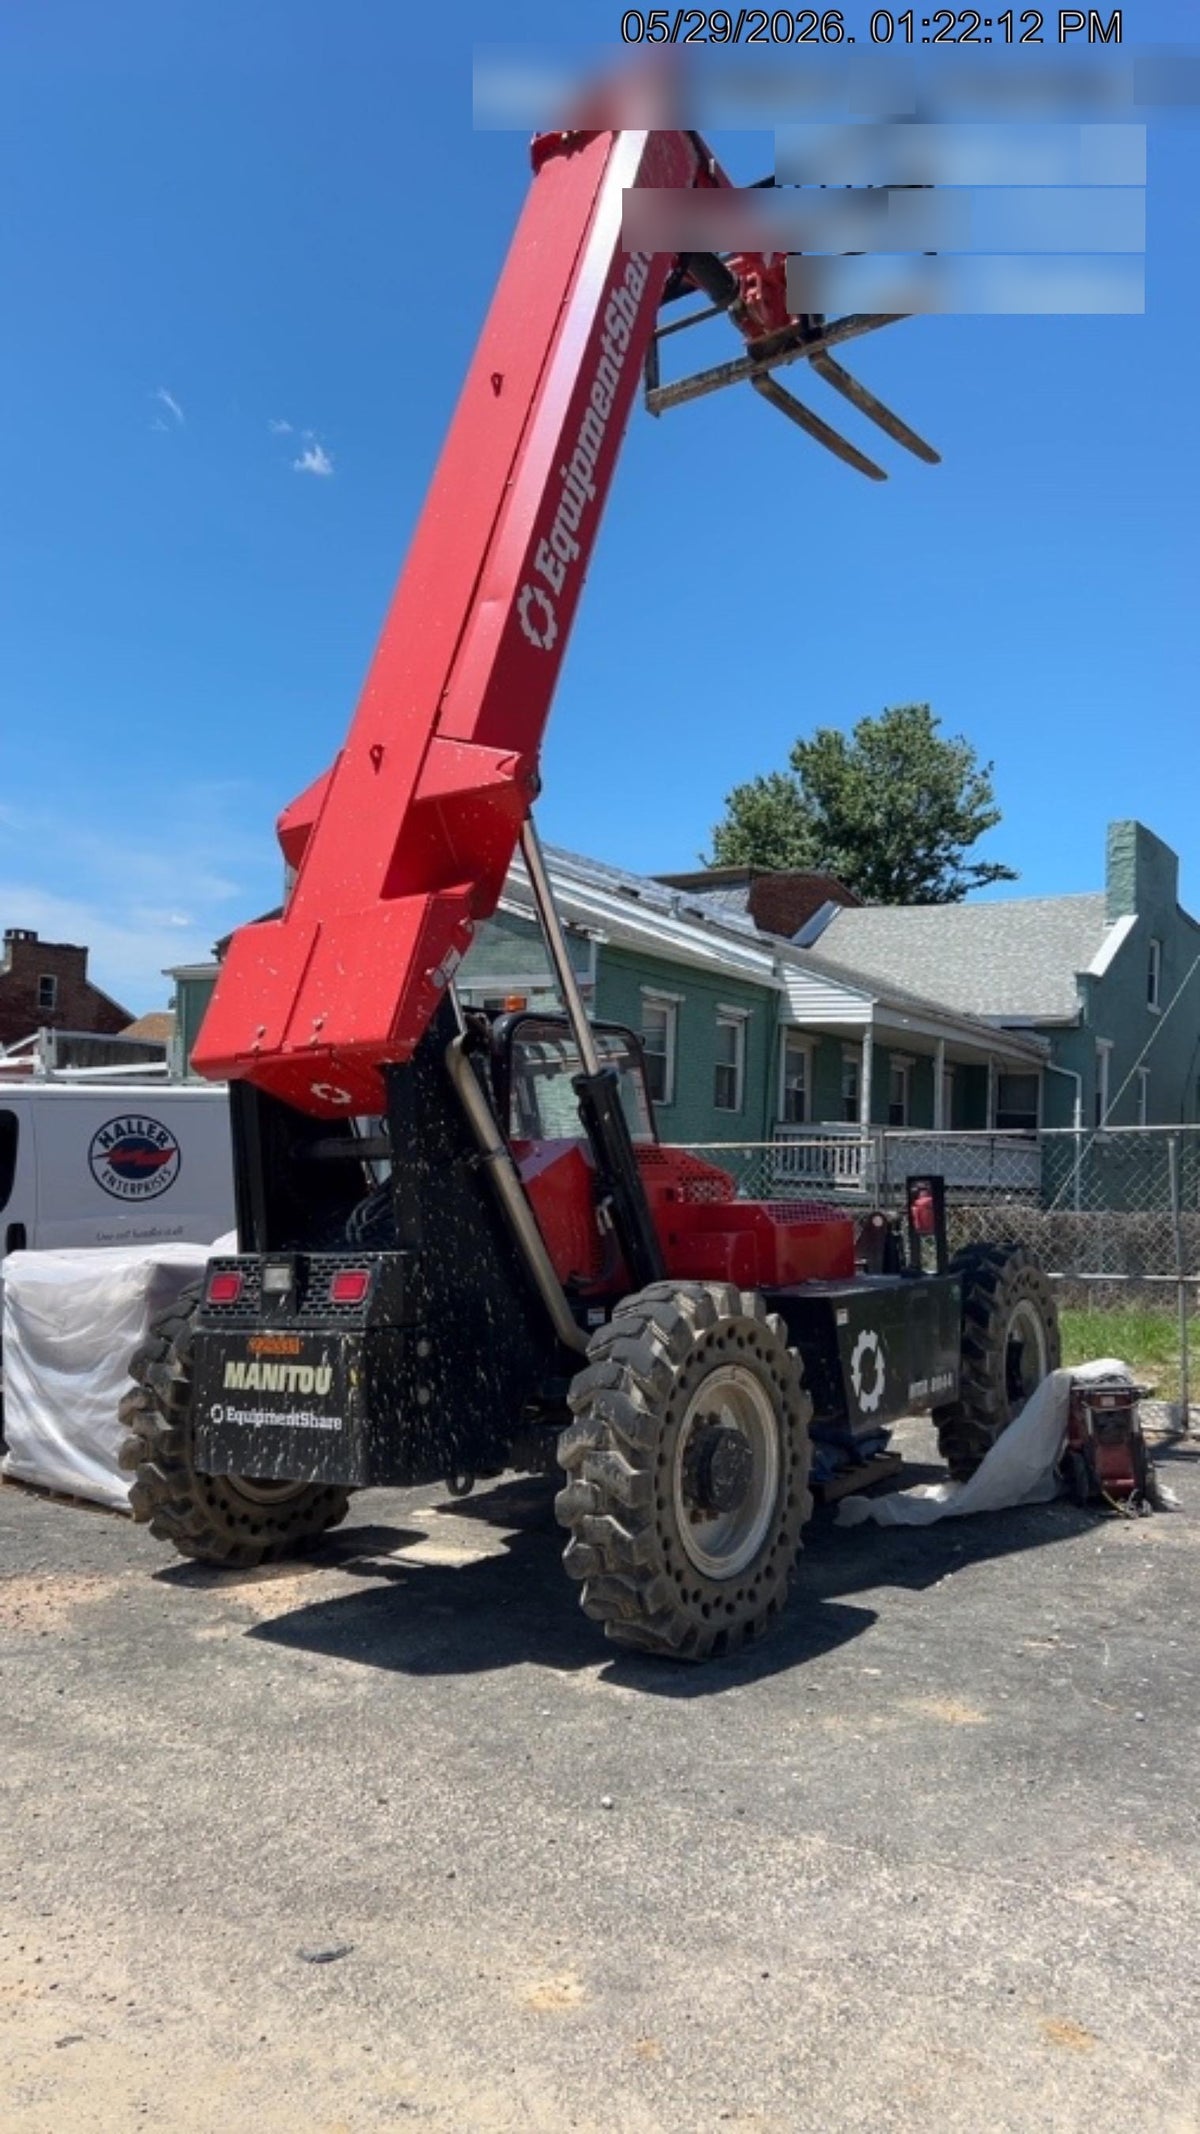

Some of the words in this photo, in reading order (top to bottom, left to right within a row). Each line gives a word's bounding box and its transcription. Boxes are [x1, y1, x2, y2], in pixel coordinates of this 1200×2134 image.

[98, 1119, 169, 1149] HALLER
[101, 1168, 172, 1195] ENTERPRISES
[223, 1361, 332, 1395] MANITOU
[226, 1406, 342, 1430] EquipmentShare
